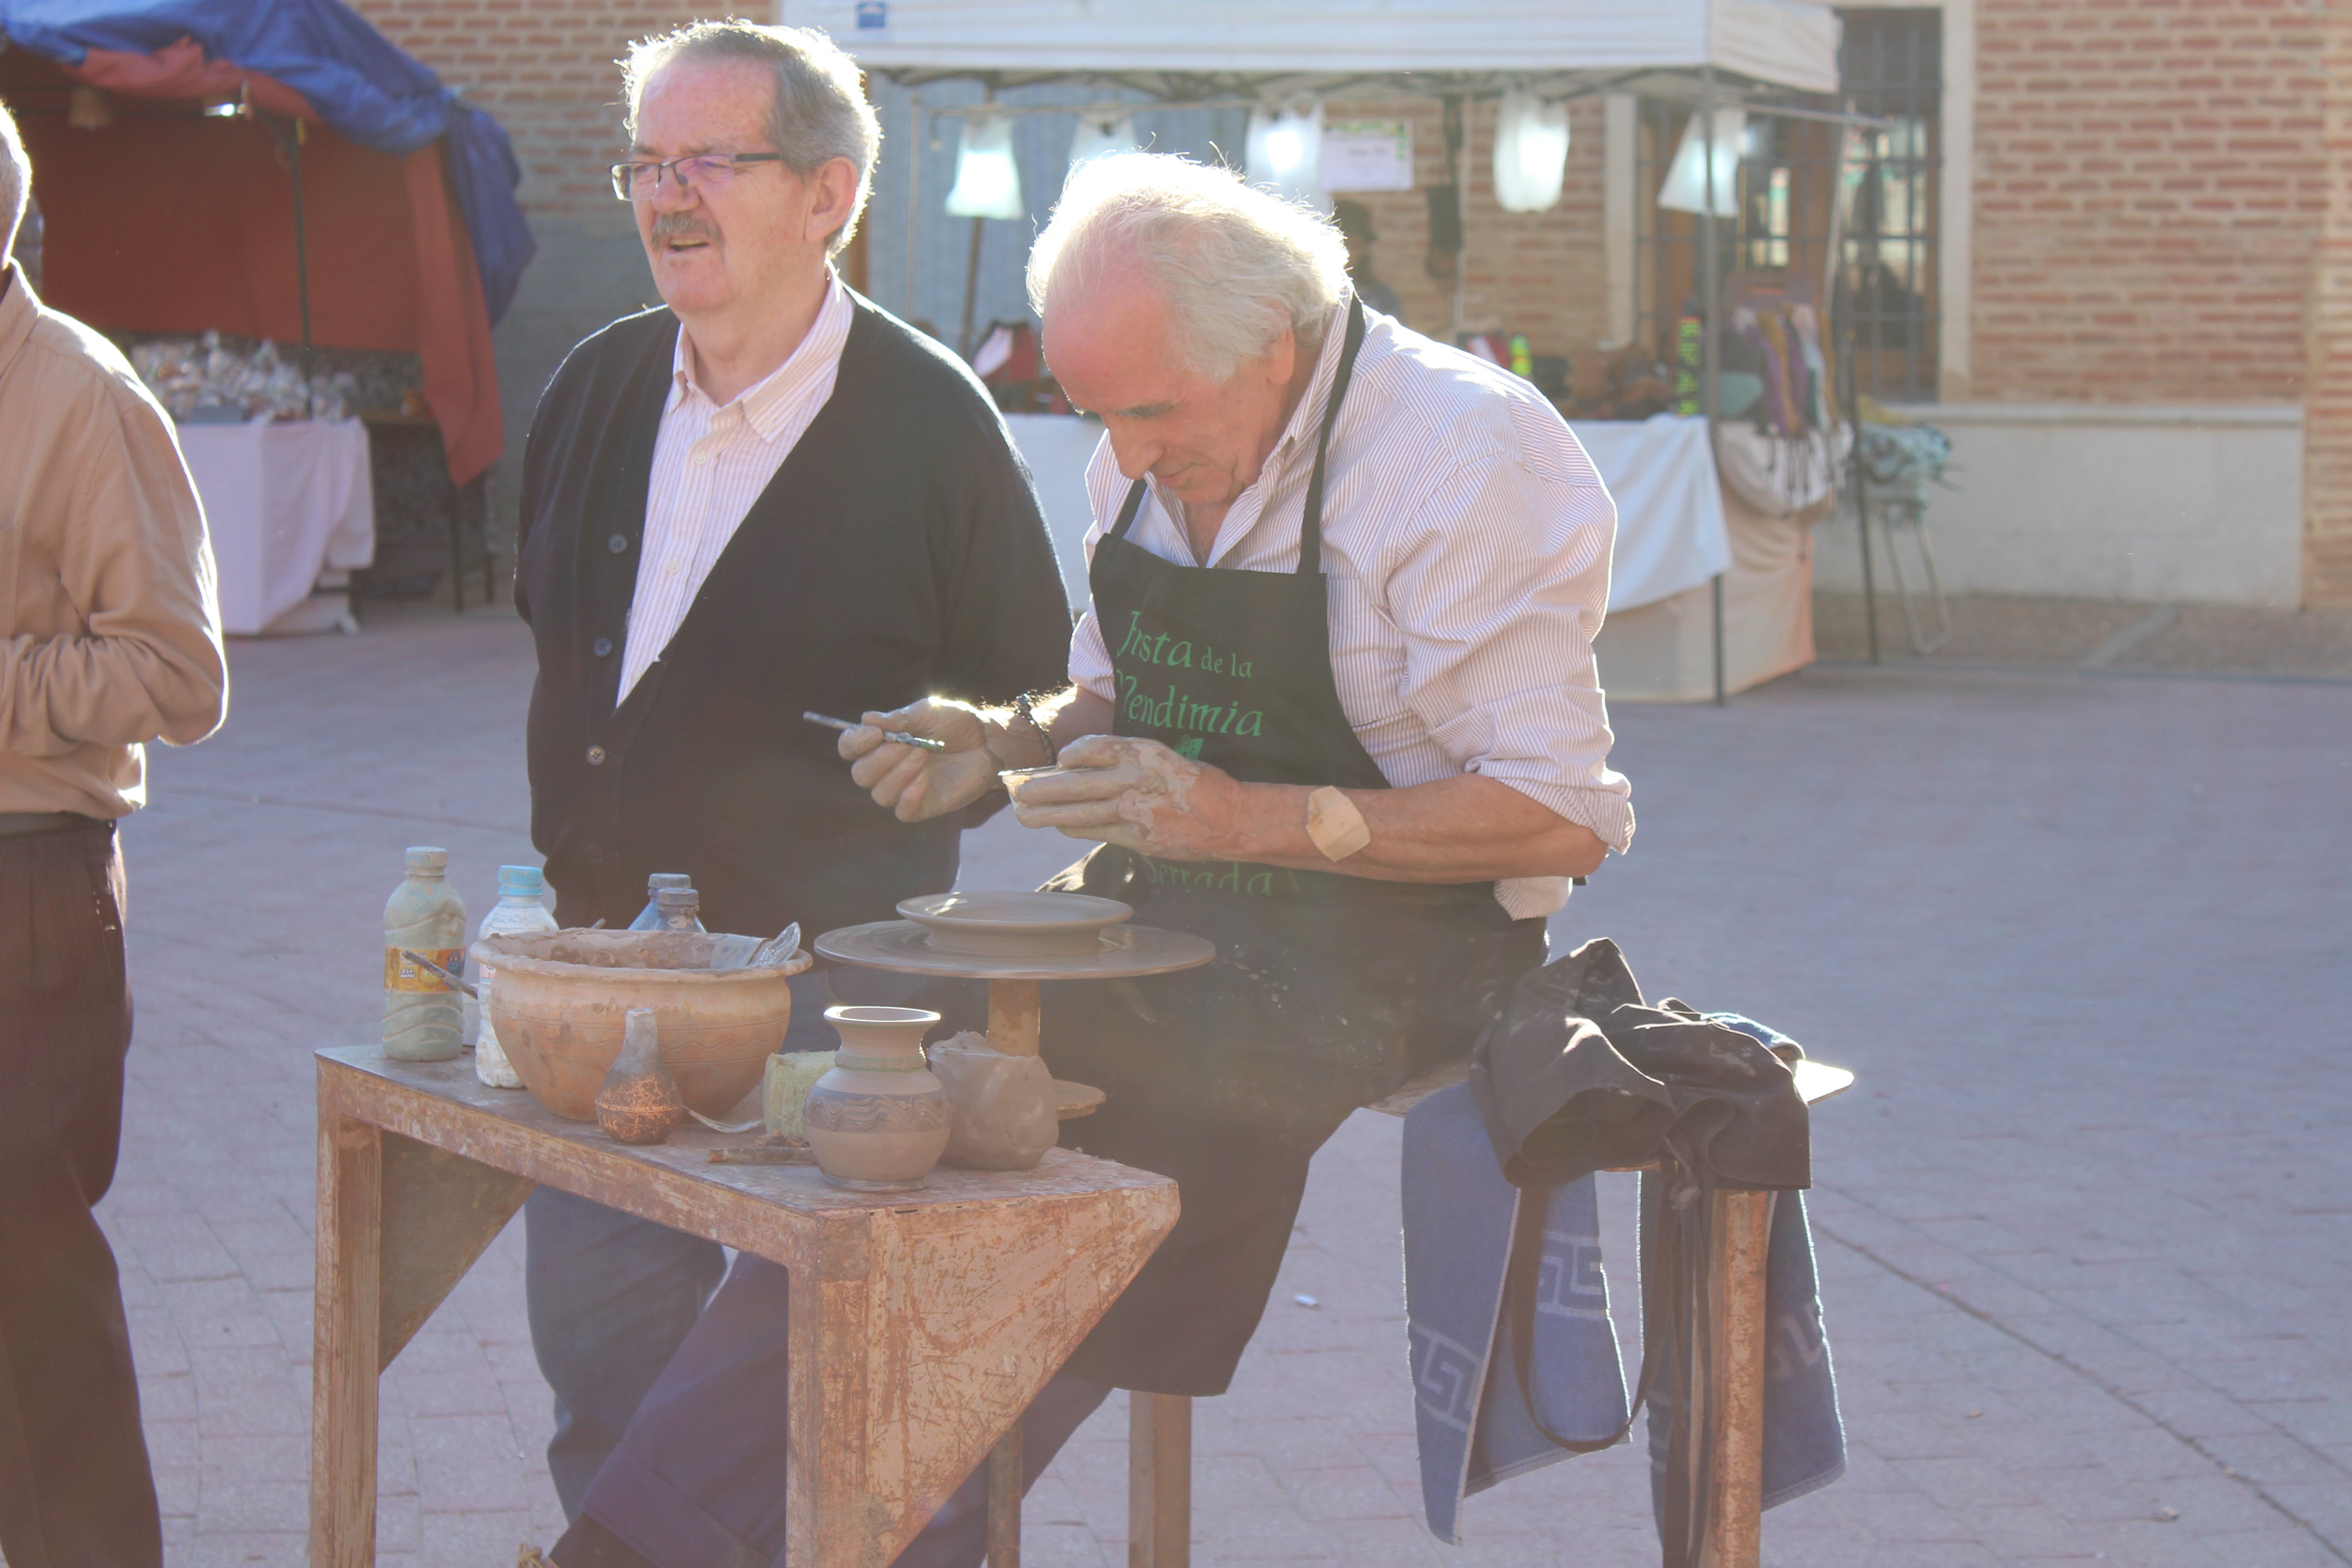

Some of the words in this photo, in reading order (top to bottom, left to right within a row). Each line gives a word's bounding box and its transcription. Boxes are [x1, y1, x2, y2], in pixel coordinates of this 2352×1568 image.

[1201, 647, 1223, 673] de
[1230, 653, 1252, 678] la
[1116, 669, 1263, 736] Vendimia
